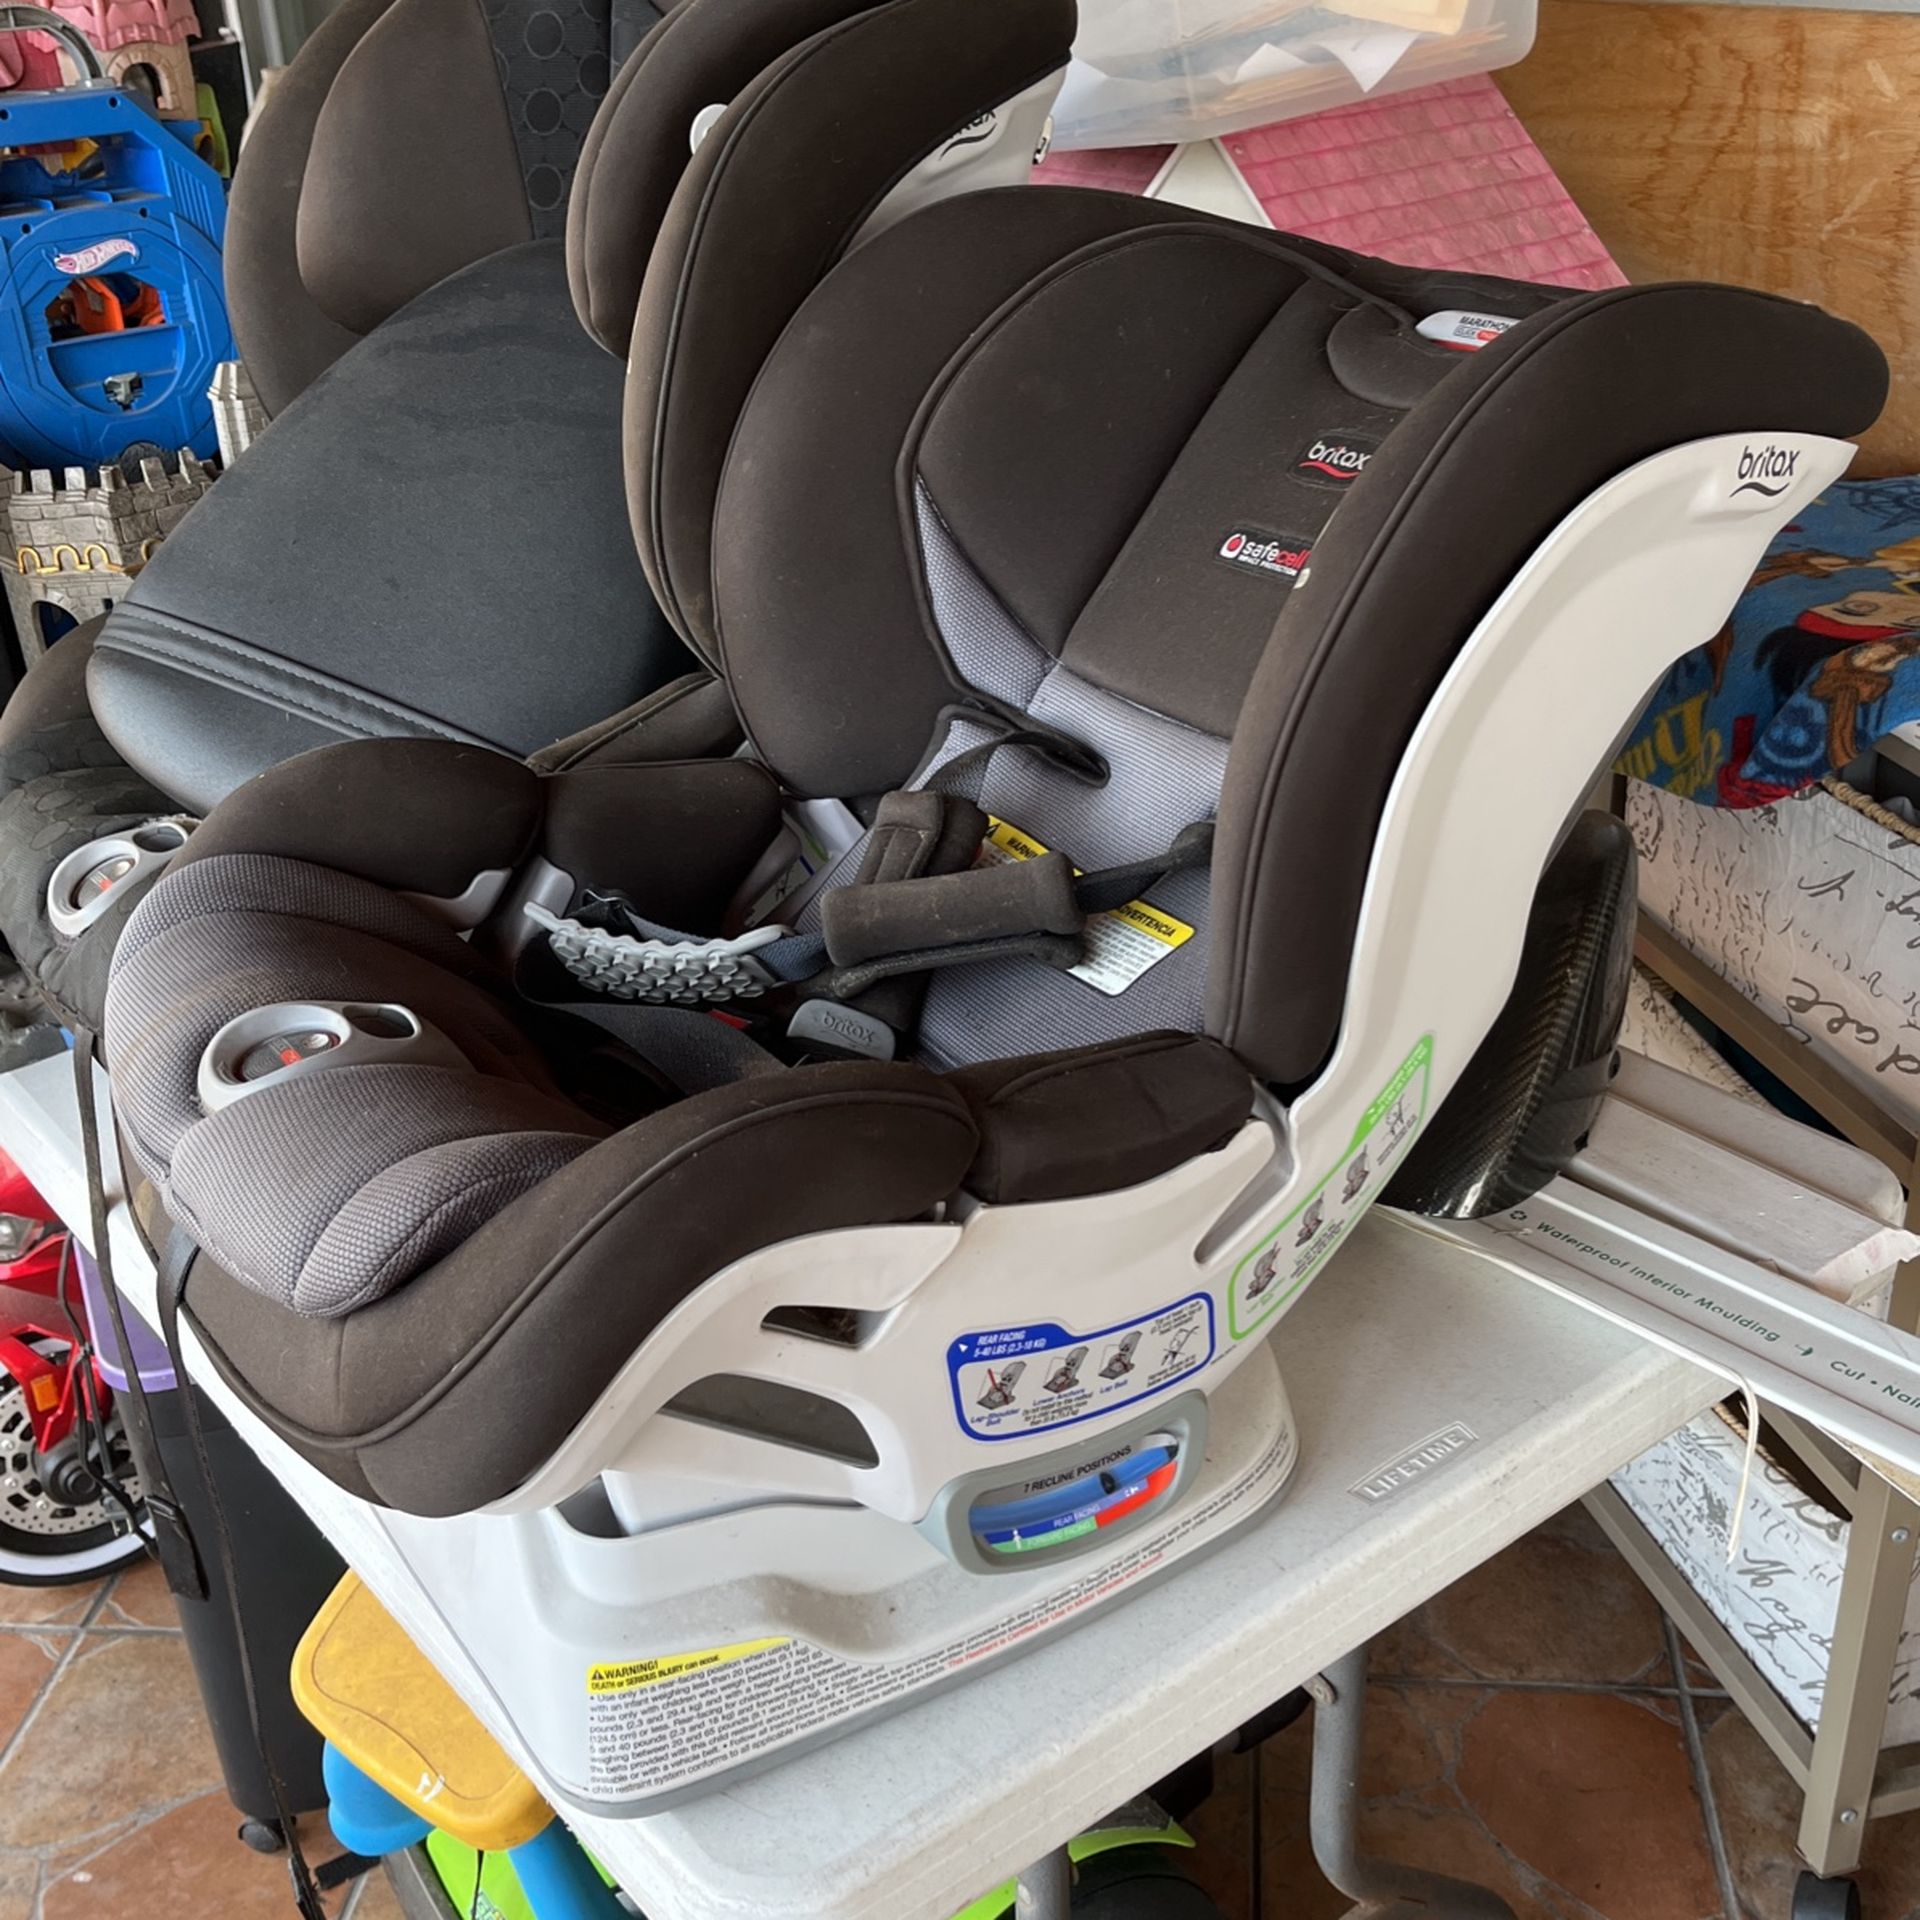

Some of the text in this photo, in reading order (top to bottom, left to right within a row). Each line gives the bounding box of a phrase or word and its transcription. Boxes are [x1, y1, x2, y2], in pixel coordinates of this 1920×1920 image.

[1308, 440, 1371, 470] britax
[1738, 445, 1800, 480] britax
[824, 1011, 875, 1043] britax
[1537, 1221, 1630, 1269] Waterproof
[1630, 1266, 1692, 1300] Interior
[1695, 1297, 1781, 1343] Moulding
[1830, 1360, 1866, 1381] Cut
[1031, 1470, 1075, 1491] RECLINE
[1076, 1445, 1132, 1476] POSITIONS
[1363, 1433, 1466, 1497] LIFETIME
[604, 1659, 658, 1679] WARNING!
